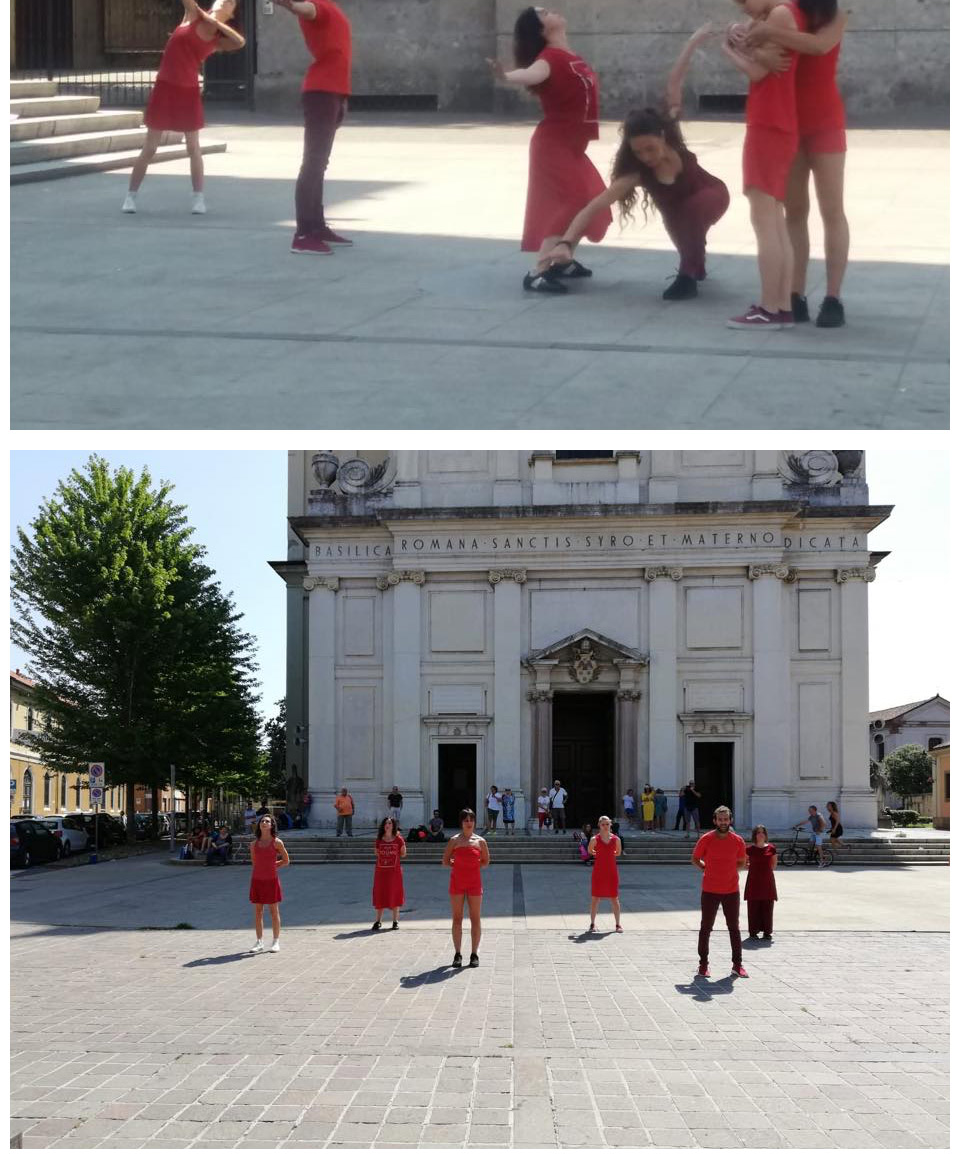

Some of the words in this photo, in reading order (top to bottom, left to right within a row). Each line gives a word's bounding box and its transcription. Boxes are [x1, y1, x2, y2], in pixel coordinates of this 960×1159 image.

[315, 545, 392, 557] BASILICA
[401, 538, 478, 550] ROMANA
[492, 536, 571, 549] SANCTIS
[585, 535, 634, 547] SYRO
[648, 534, 667, 546] ET
[681, 532, 774, 545] MATERNO
[783, 536, 860, 549] DICATA
